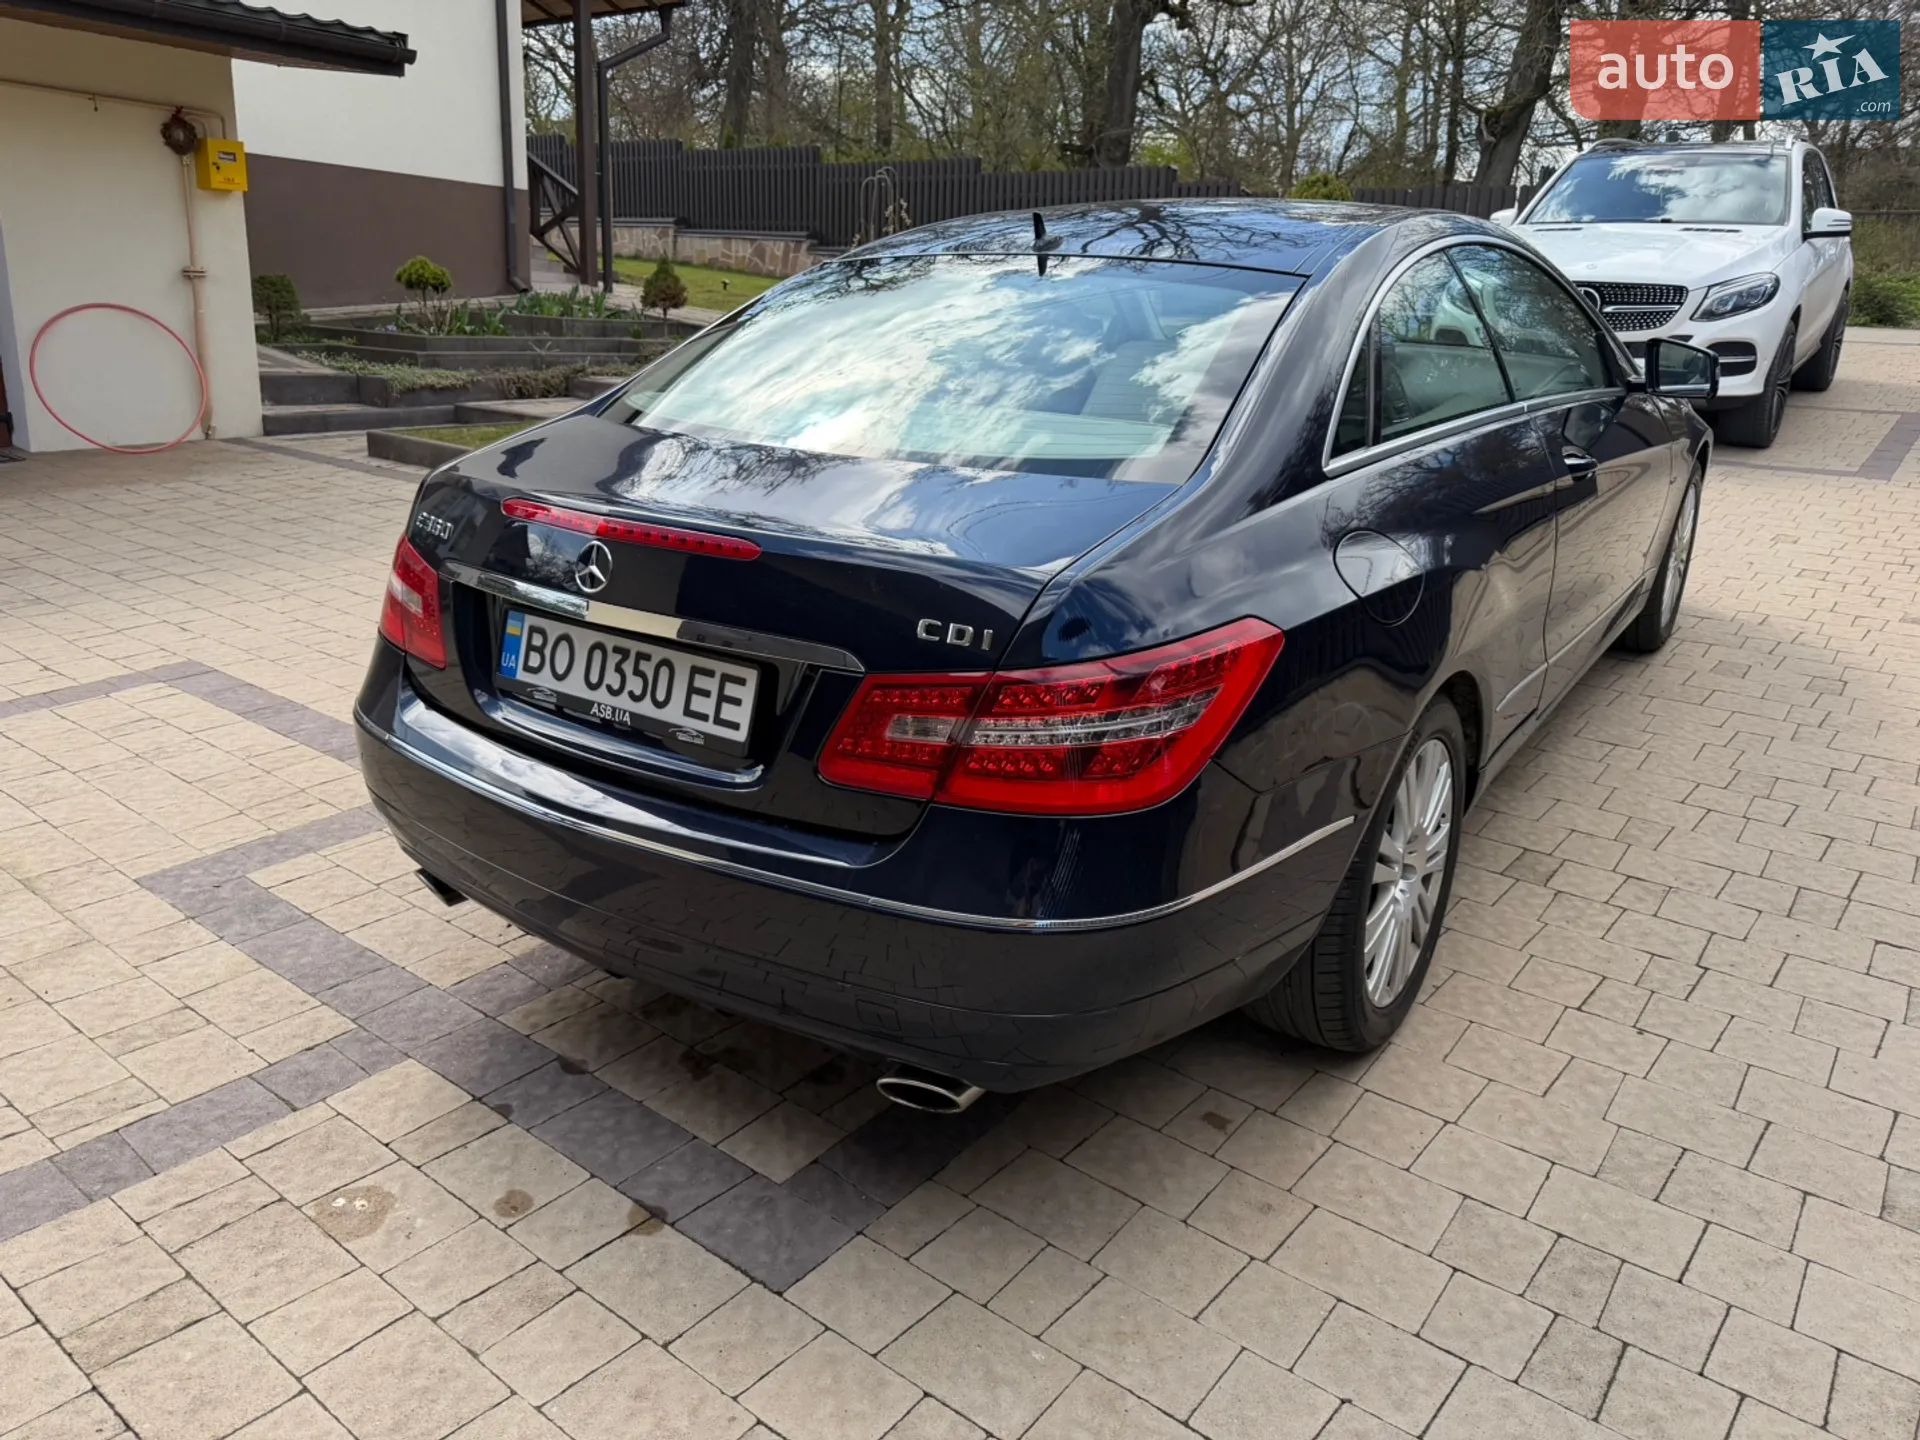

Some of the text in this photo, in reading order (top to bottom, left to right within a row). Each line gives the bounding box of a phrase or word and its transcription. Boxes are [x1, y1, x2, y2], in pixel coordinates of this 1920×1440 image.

[916, 618, 994, 651] CDI
[501, 650, 517, 669] UA
[522, 624, 748, 732] BO 0350 EE
[590, 702, 631, 726] ASB.UA
